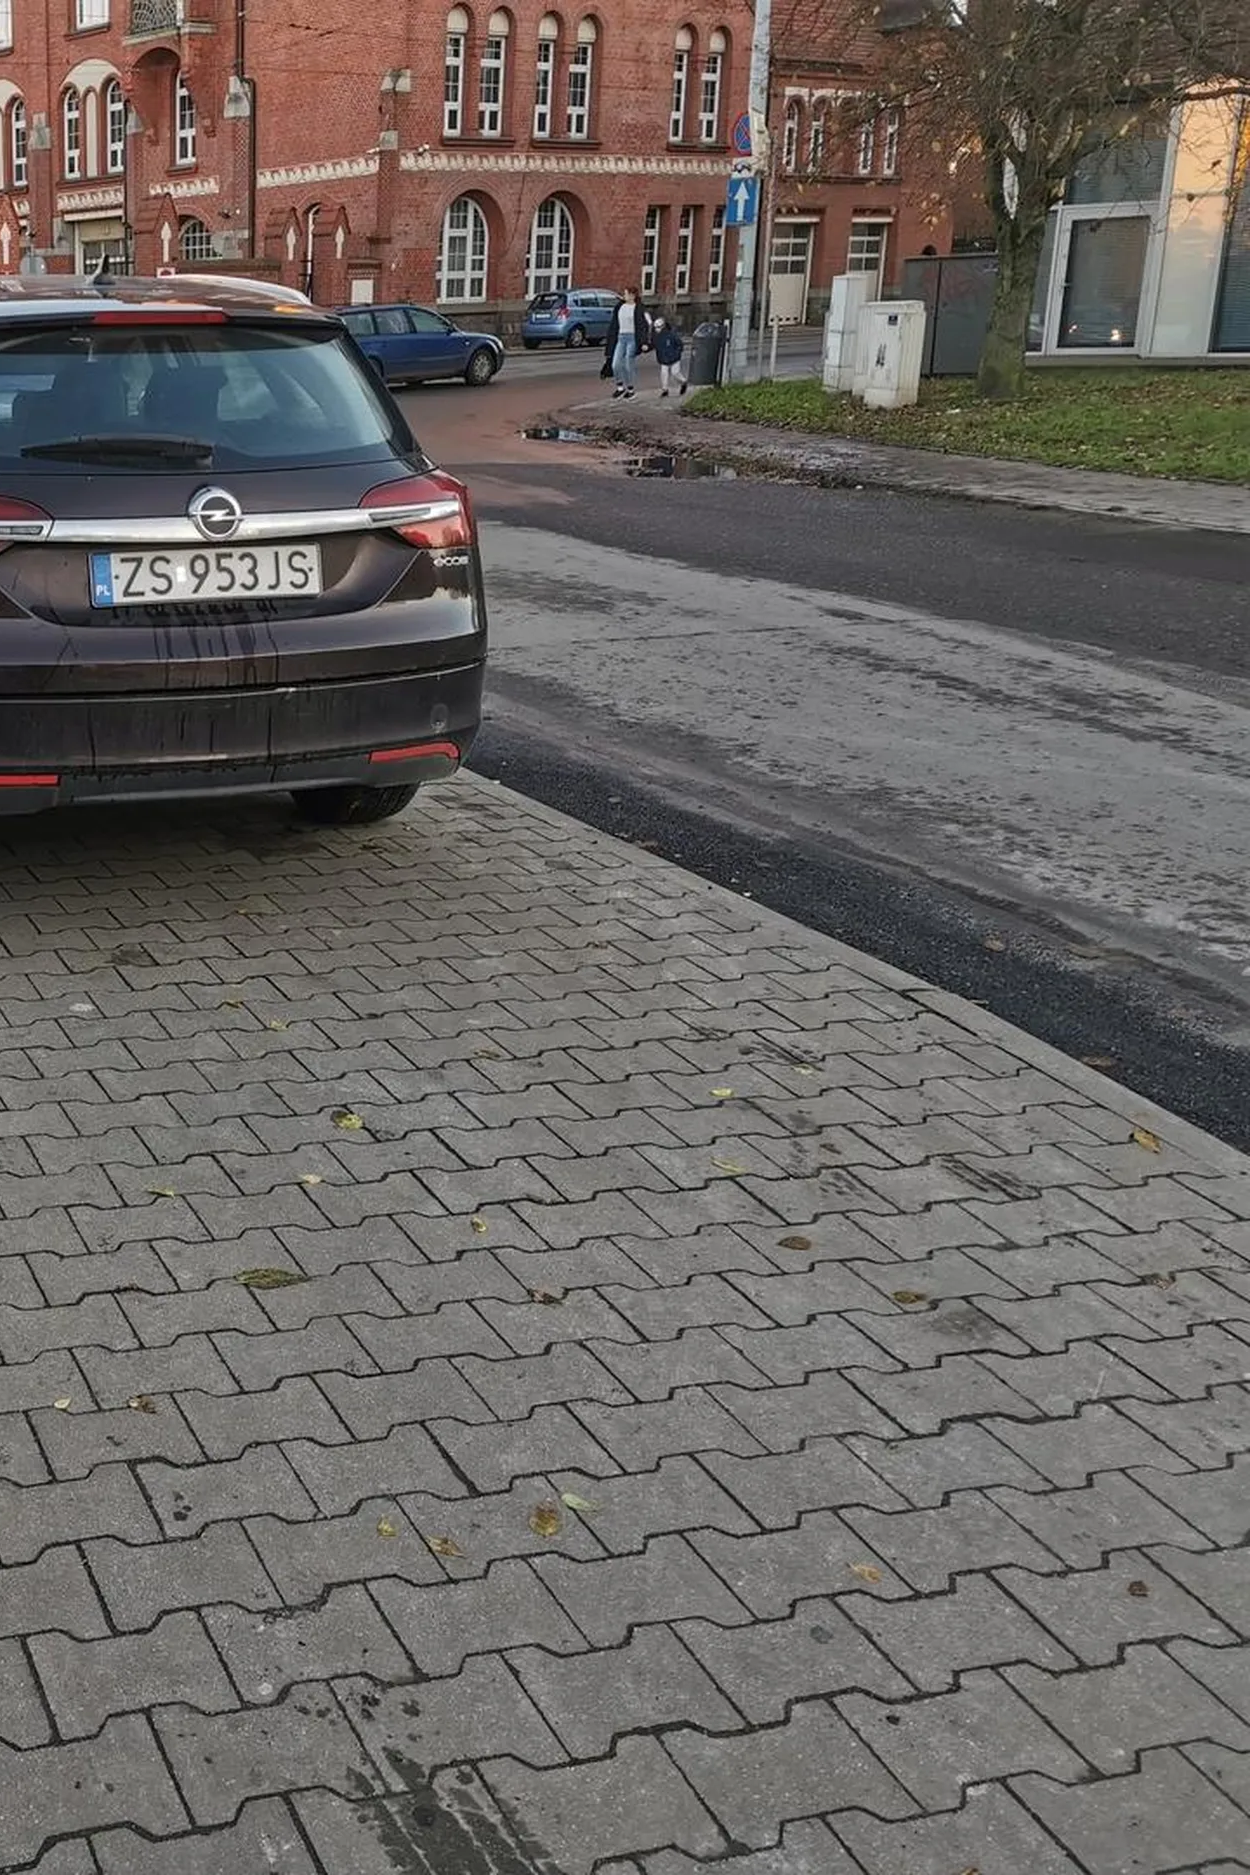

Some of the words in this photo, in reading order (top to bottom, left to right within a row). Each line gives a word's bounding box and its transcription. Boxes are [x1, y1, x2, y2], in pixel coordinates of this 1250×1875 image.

[120, 556, 173, 597] ZS
[189, 551, 308, 594] 953JS
[96, 585, 111, 596] PL
